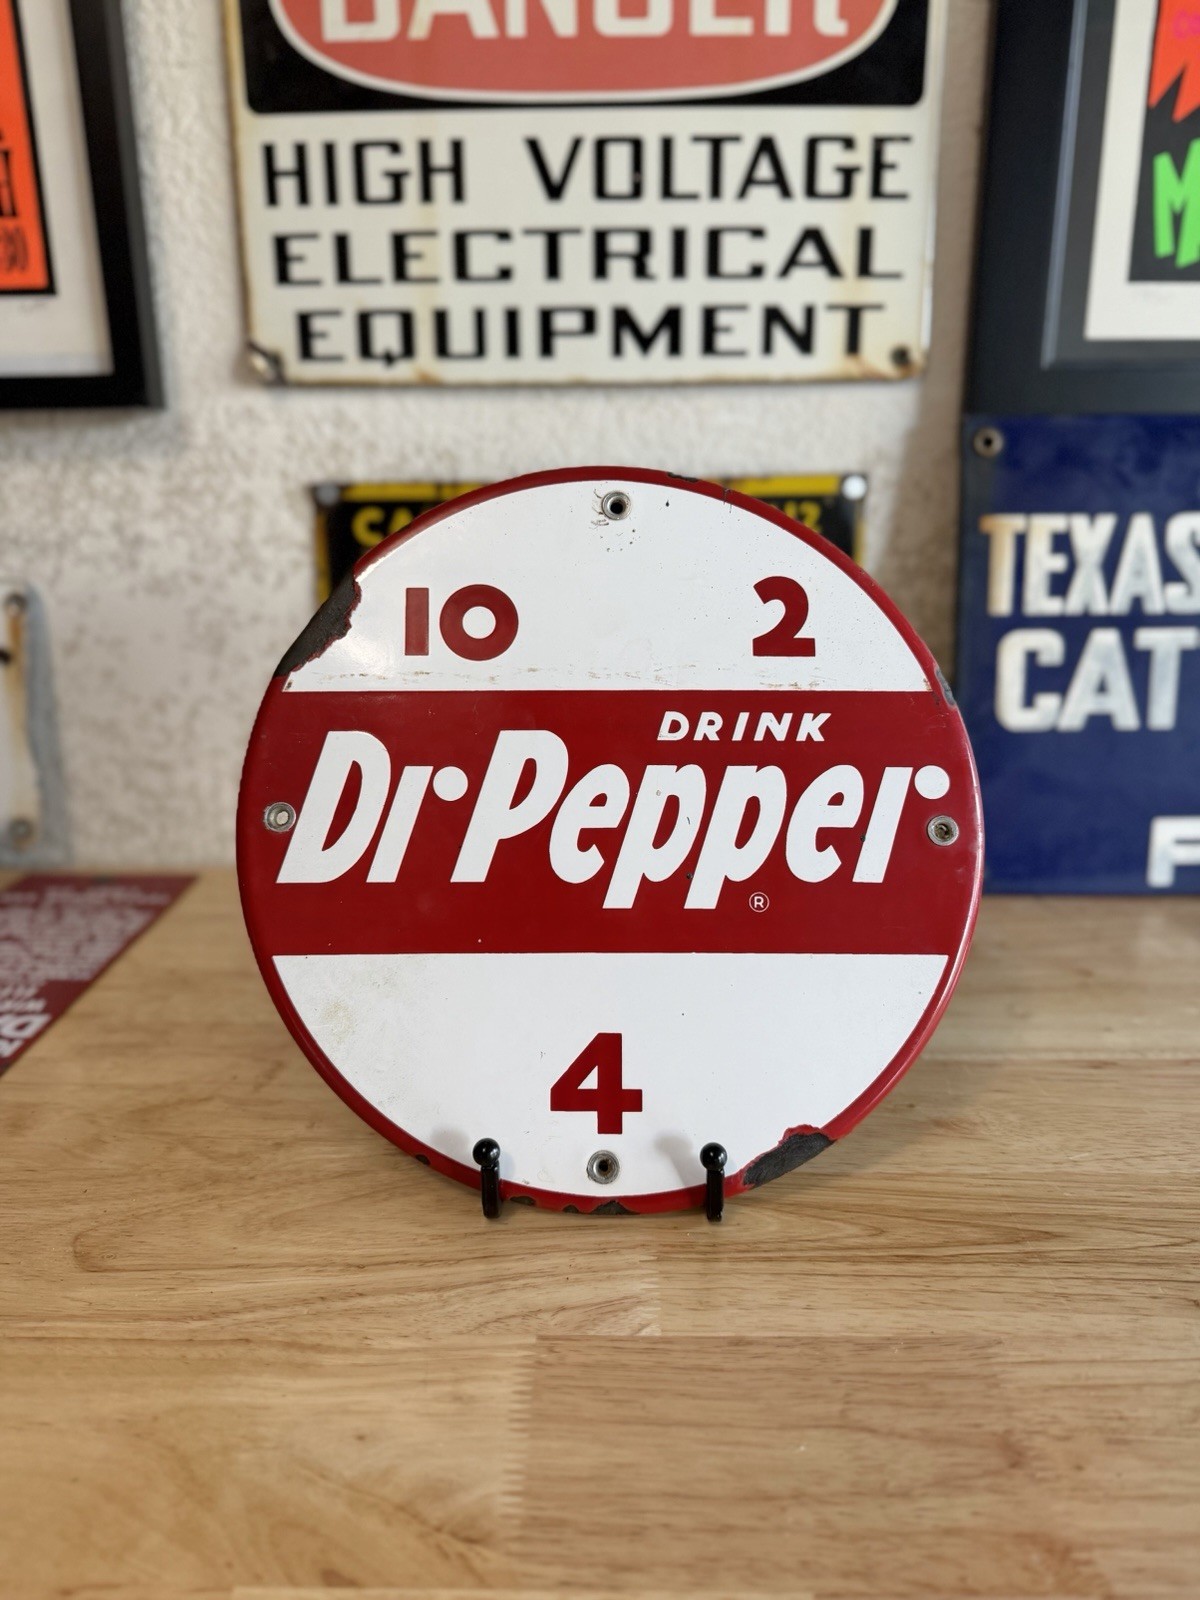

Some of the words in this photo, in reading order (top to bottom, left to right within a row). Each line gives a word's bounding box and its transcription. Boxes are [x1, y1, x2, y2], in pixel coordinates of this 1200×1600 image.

[262, 138, 465, 207] HIGH
[524, 135, 912, 201] VOLTAGE
[272, 226, 904, 286] ELECTRICAL
[296, 305, 885, 368] EQUIPMENT
[979, 511, 1200, 617] TEXAS
[405, 584, 519, 661] 10
[753, 575, 816, 657] 2
[657, 711, 832, 742] DRINK
[550, 1032, 643, 1134] 4
